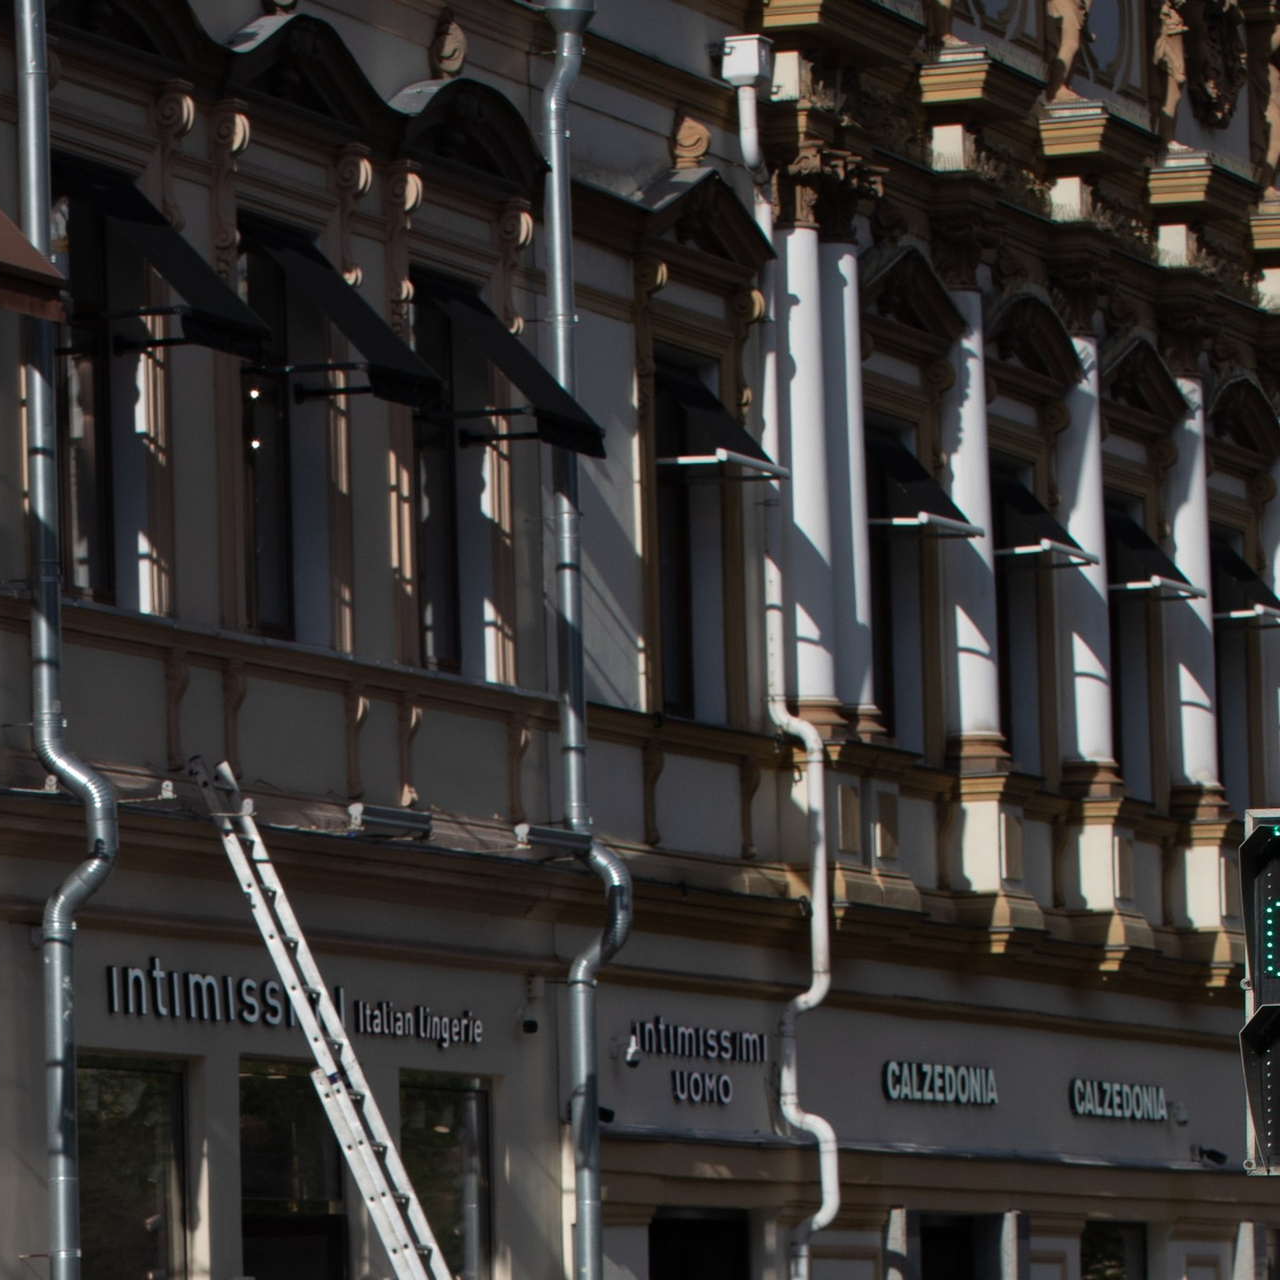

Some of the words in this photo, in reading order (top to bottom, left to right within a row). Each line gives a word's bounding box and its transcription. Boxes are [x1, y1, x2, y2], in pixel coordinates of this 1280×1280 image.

[107, 956, 347, 1030] intimissii
[357, 1000, 414, 1036] Italian
[417, 1006, 483, 1048] lingerie
[632, 1016, 768, 1063] intimissimi
[673, 1070, 733, 1105] UOMO
[884, 1060, 999, 1105] CALZEDONIA
[1071, 1078, 1169, 1121] CALZEDONIA
